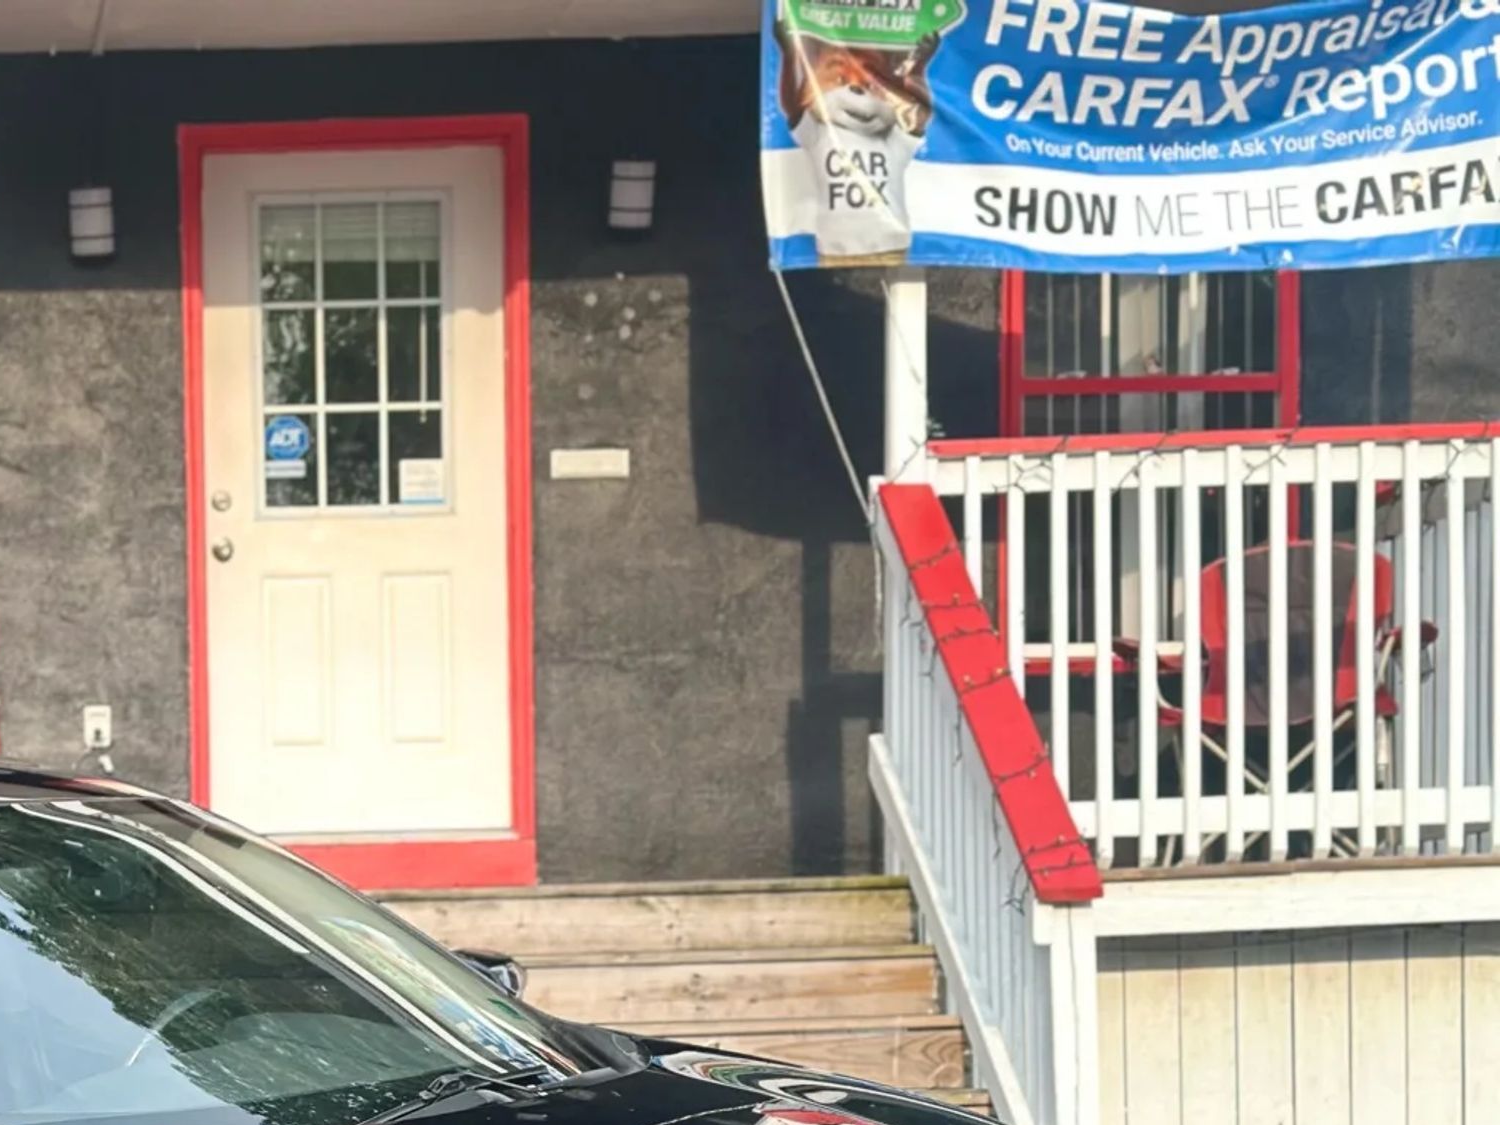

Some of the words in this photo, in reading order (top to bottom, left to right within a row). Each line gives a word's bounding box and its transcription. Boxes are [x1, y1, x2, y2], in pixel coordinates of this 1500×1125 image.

[857, 13, 917, 32] VALUE
[985, 0, 1174, 63] FREE
[1005, 132, 1032, 154] On
[1031, 138, 1072, 160] Your
[1075, 140, 1145, 164] Current
[1148, 139, 1225, 163] Vehicle.
[1228, 136, 1268, 160] Ask
[1270, 134, 1318, 155] Your
[1321, 123, 1397, 150] Service
[1400, 110, 1484, 139] Advisor.
[825, 149, 889, 178] CAR
[828, 180, 890, 211] FOX
[973, 185, 1117, 237] SHOW
[1135, 192, 1204, 237] ME
[1212, 185, 1304, 232] THE
[1315, 156, 1500, 225] CARFA
[269, 427, 301, 448] ADT
